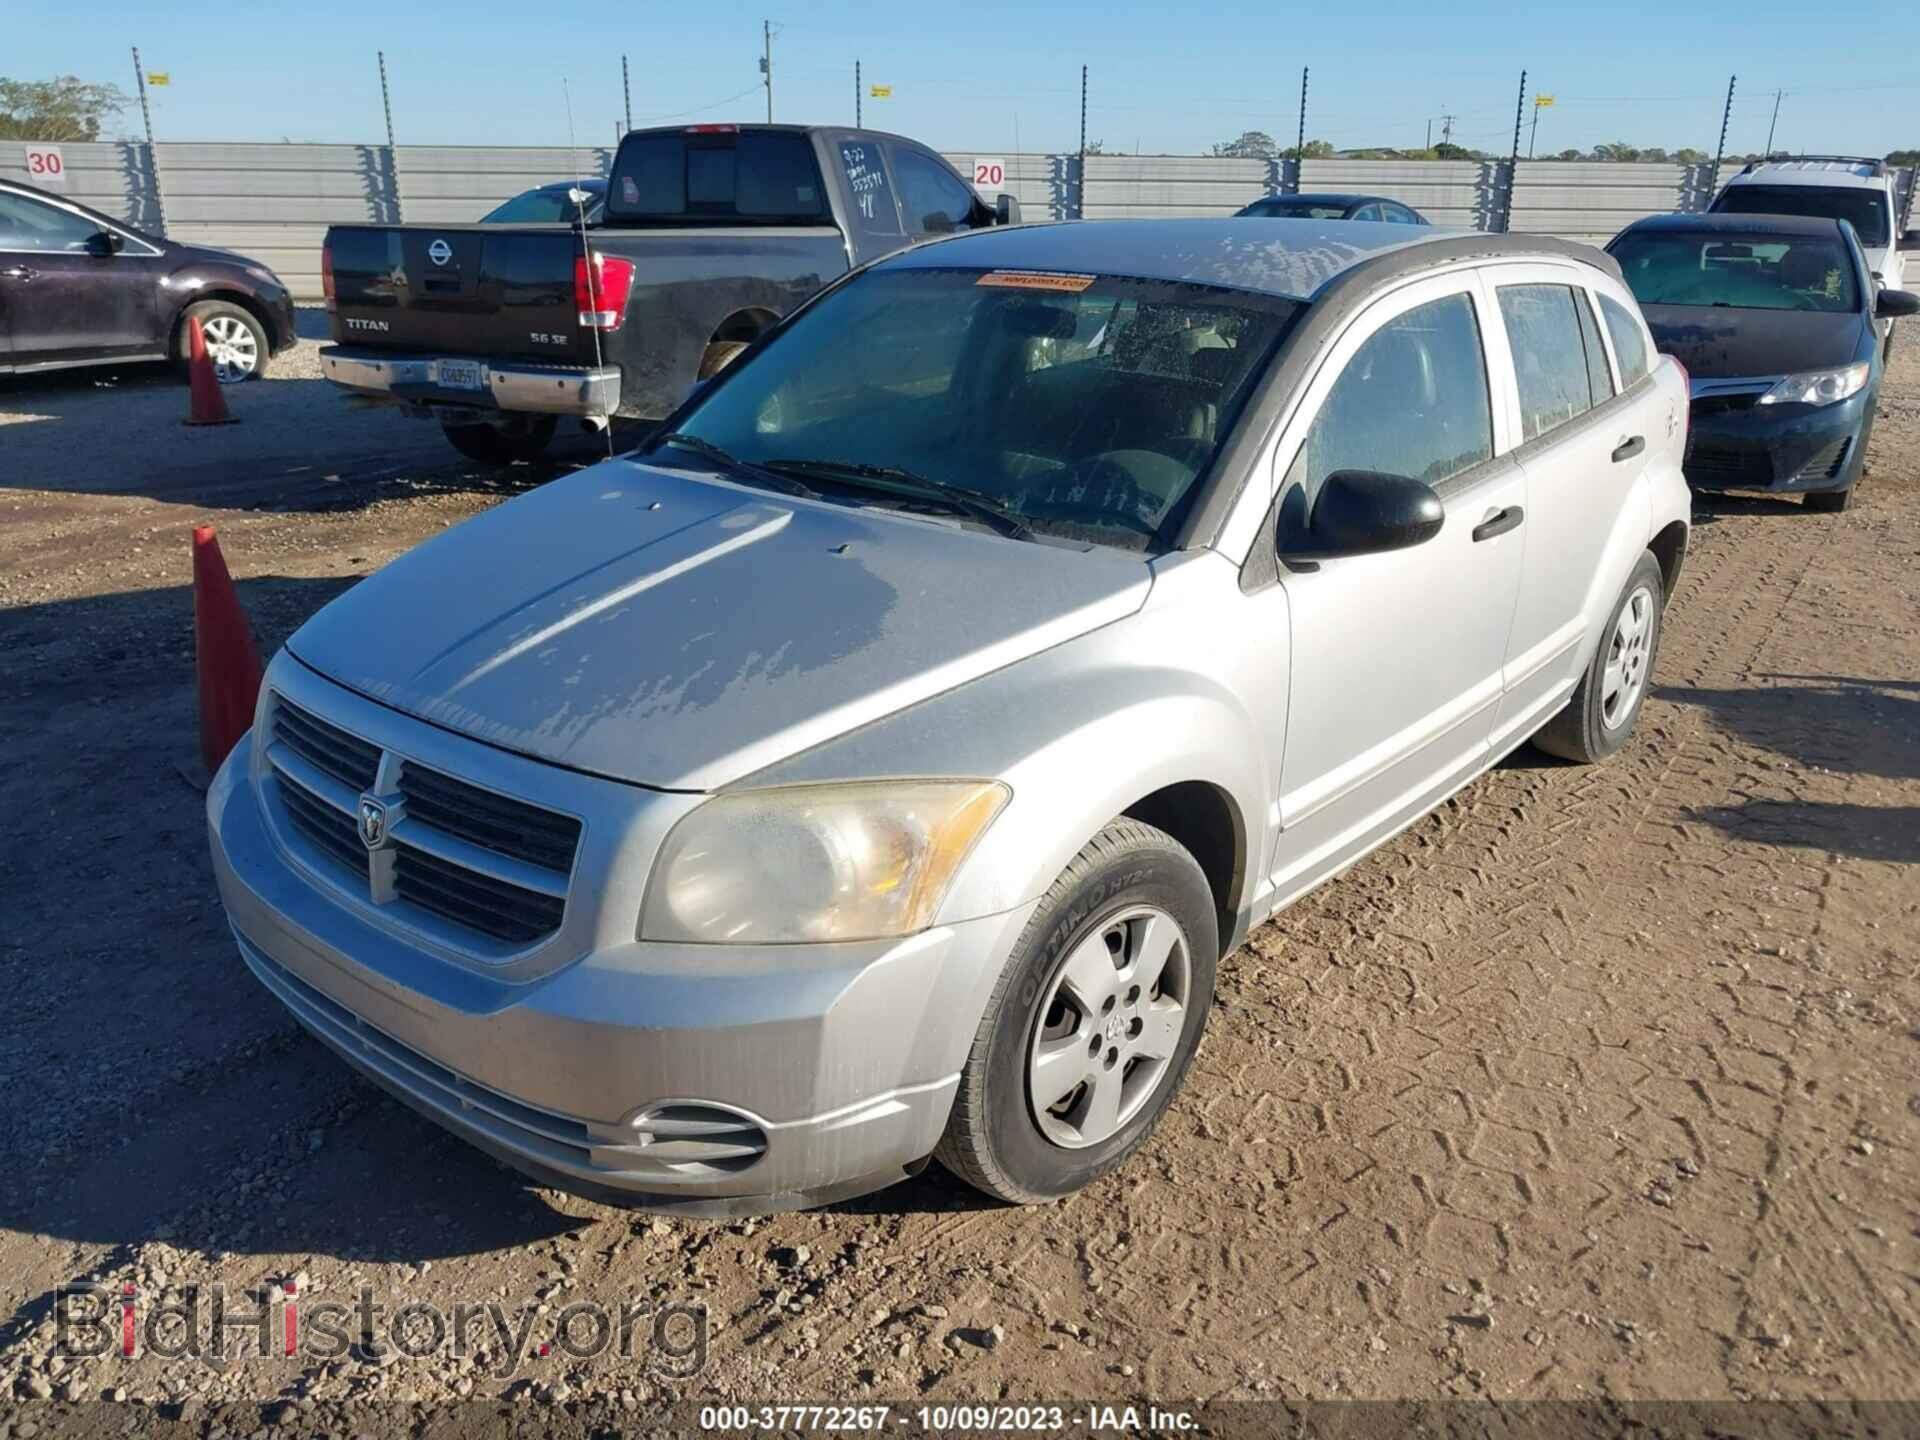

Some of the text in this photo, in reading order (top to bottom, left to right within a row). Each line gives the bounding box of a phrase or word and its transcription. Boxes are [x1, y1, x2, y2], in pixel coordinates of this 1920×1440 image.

[29, 152, 61, 174] 30
[975, 165, 1002, 185] 20
[346, 318, 389, 331] TITAN
